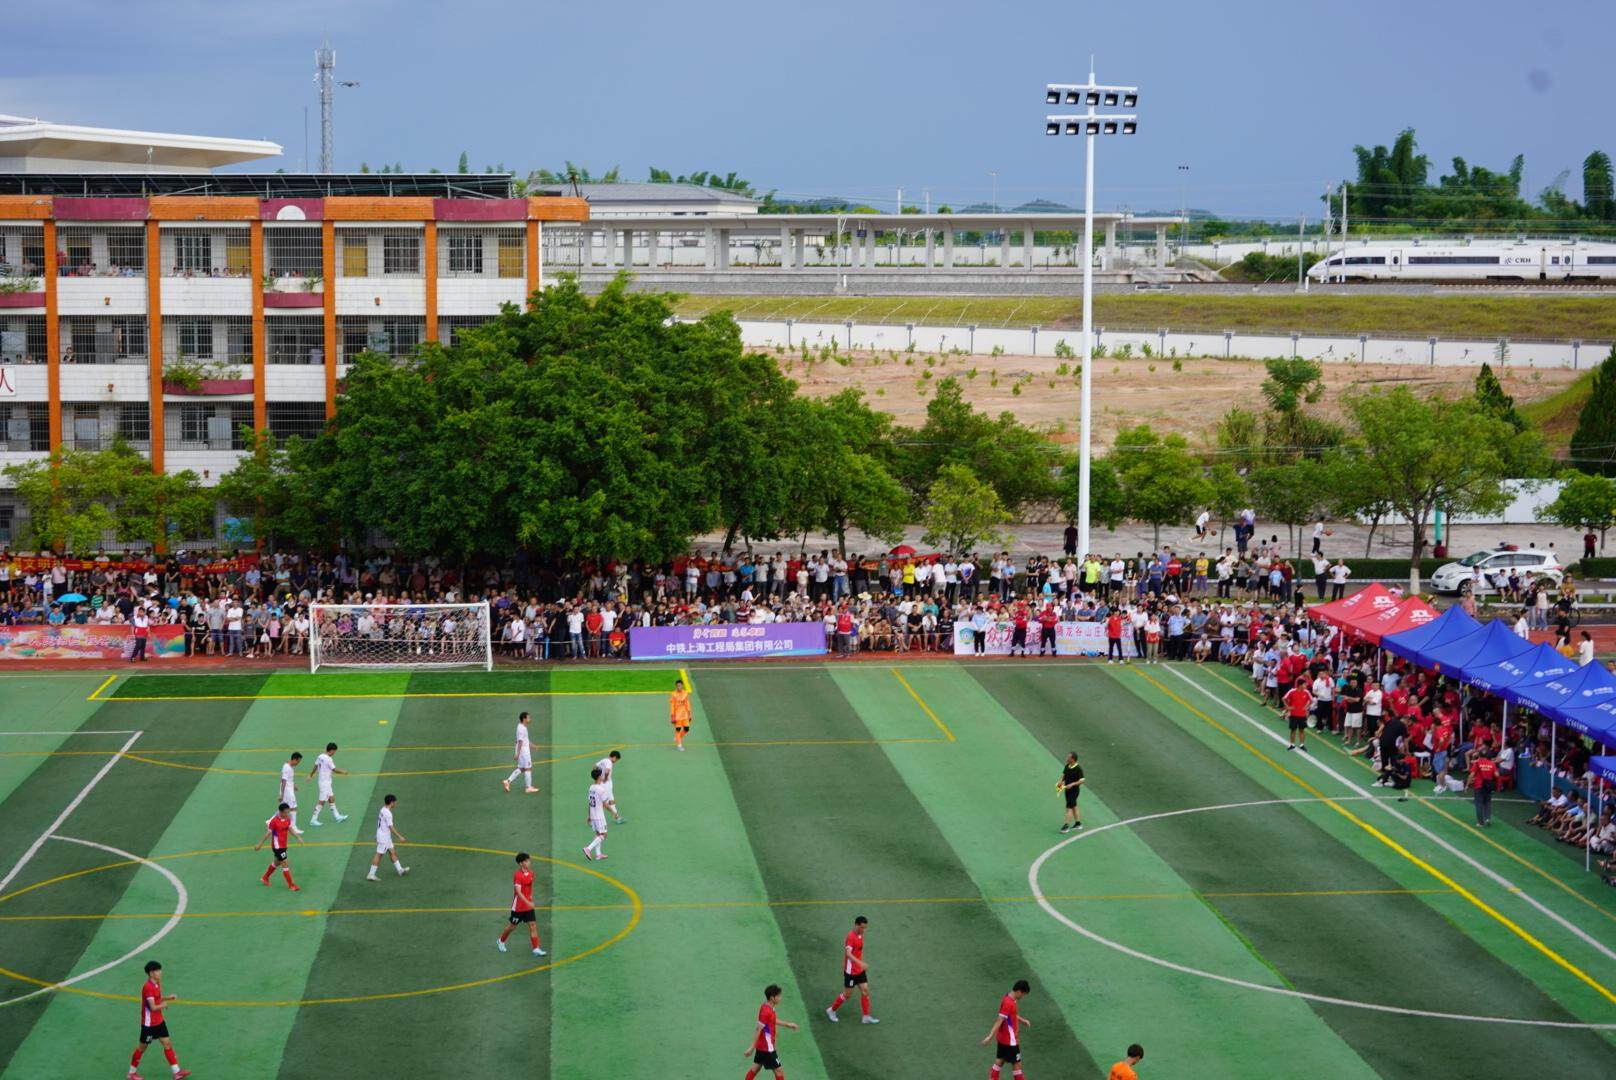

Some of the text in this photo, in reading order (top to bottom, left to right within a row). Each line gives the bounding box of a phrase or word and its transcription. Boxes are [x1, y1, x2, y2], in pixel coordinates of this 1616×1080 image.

[666, 639, 794, 654] 中铁上海工程局集团有限公司
